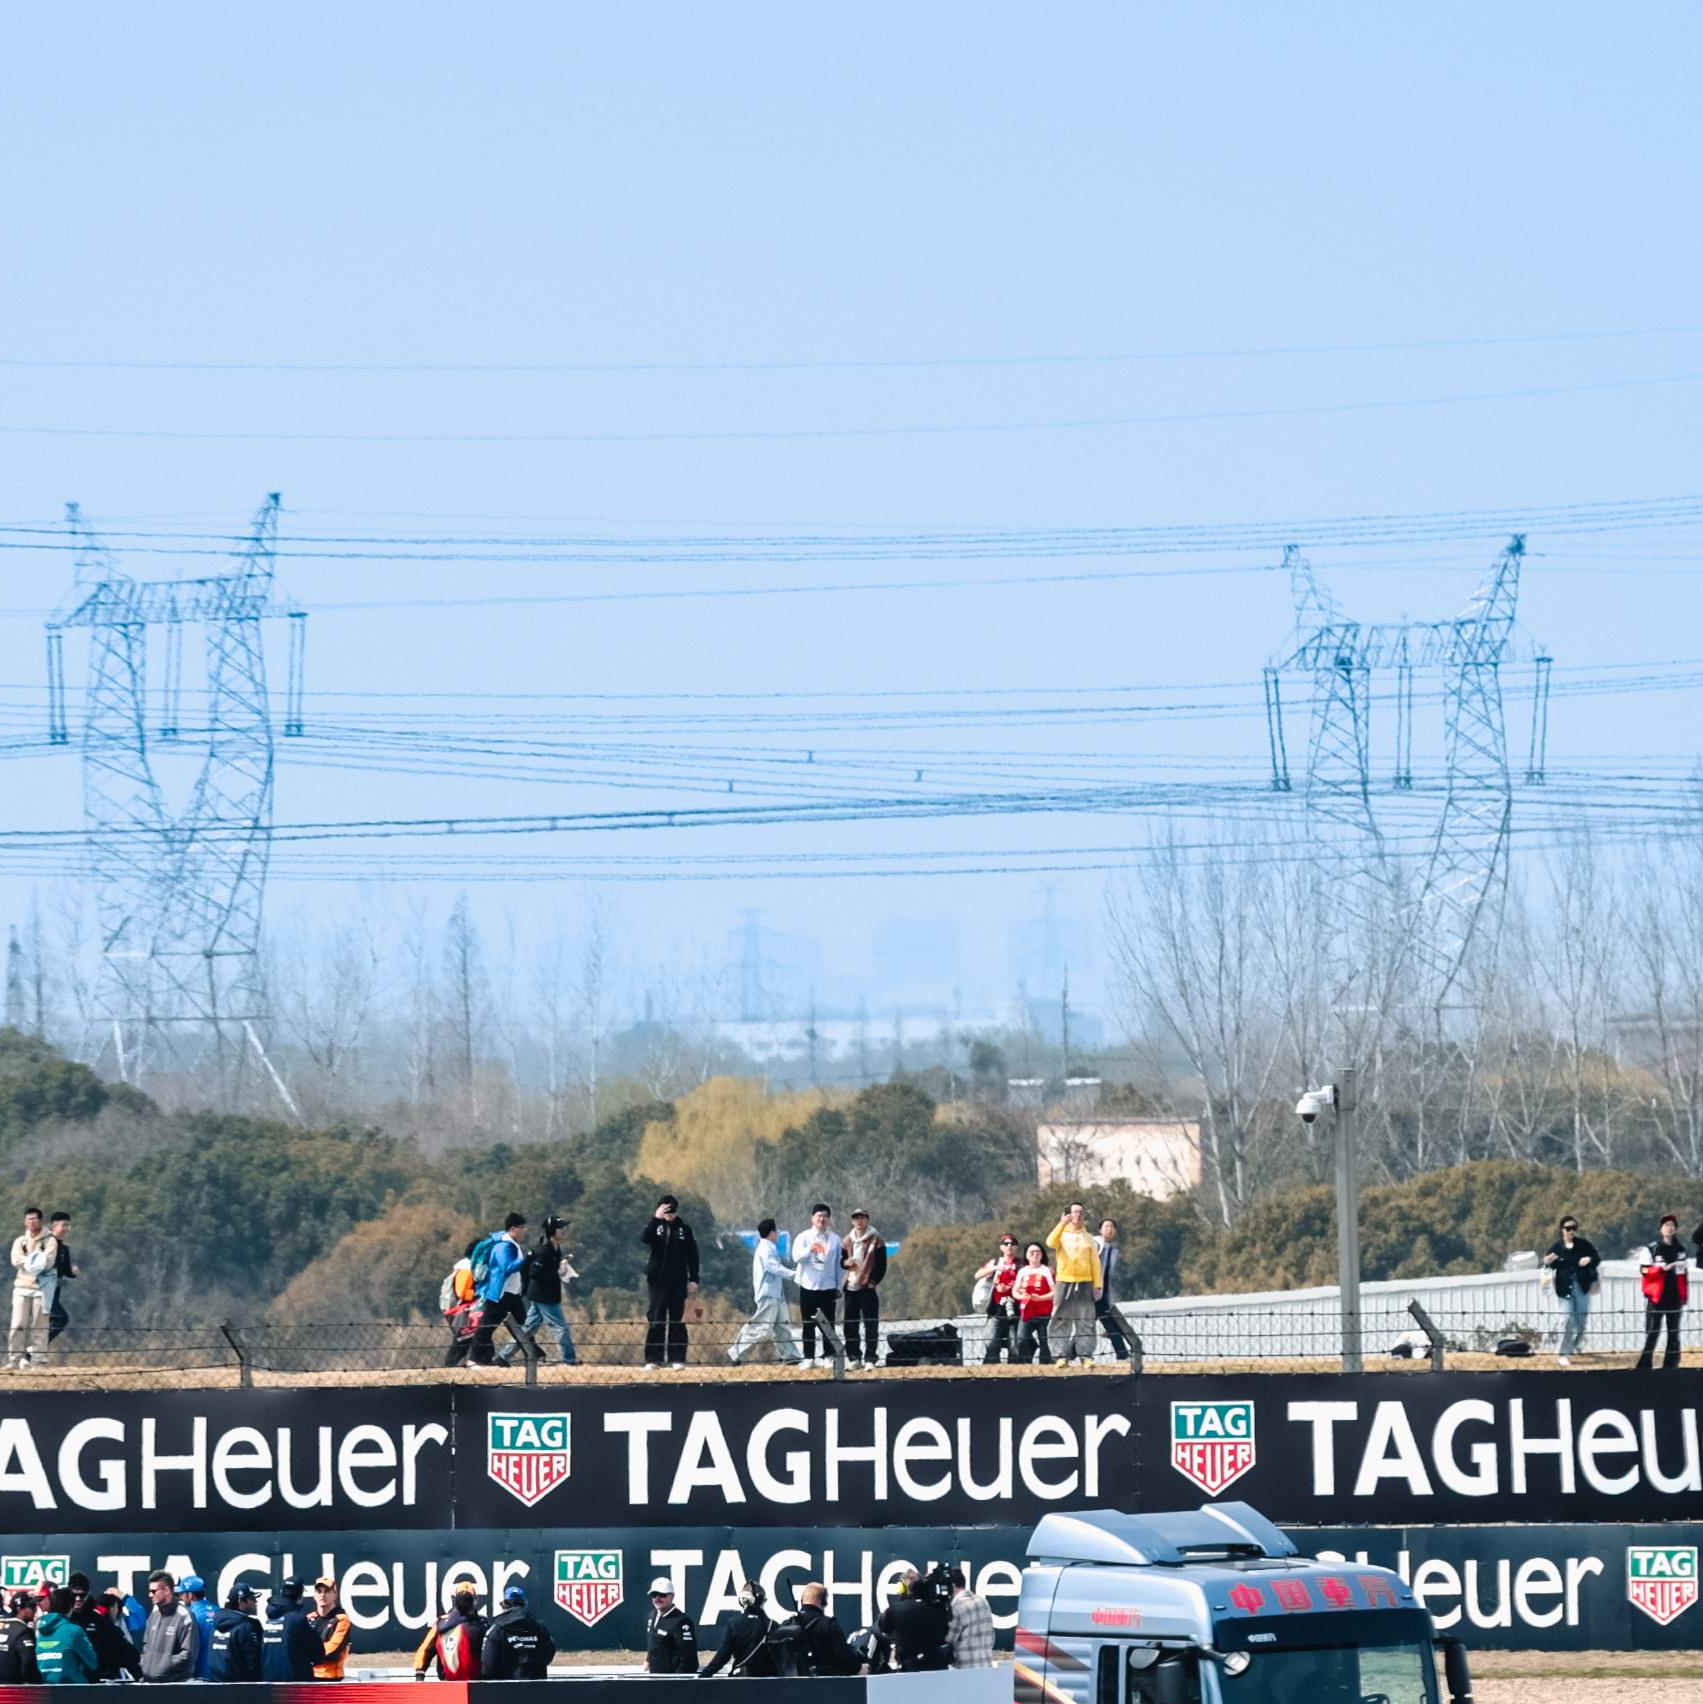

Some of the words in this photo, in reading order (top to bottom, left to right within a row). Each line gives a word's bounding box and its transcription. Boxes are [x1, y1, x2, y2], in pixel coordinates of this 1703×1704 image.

[496, 1420, 563, 1448] TAG
[1178, 1408, 1247, 1437] TAG
[492, 1455, 565, 1498] HEUER
[1176, 1444, 1252, 1489] HEUER
[7, 1561, 64, 1586] TAG
[561, 1556, 616, 1579] TAG
[1632, 1552, 1692, 1577] TAG
[558, 1584, 620, 1621] HEUER
[1632, 1582, 1696, 1620] HEUER
